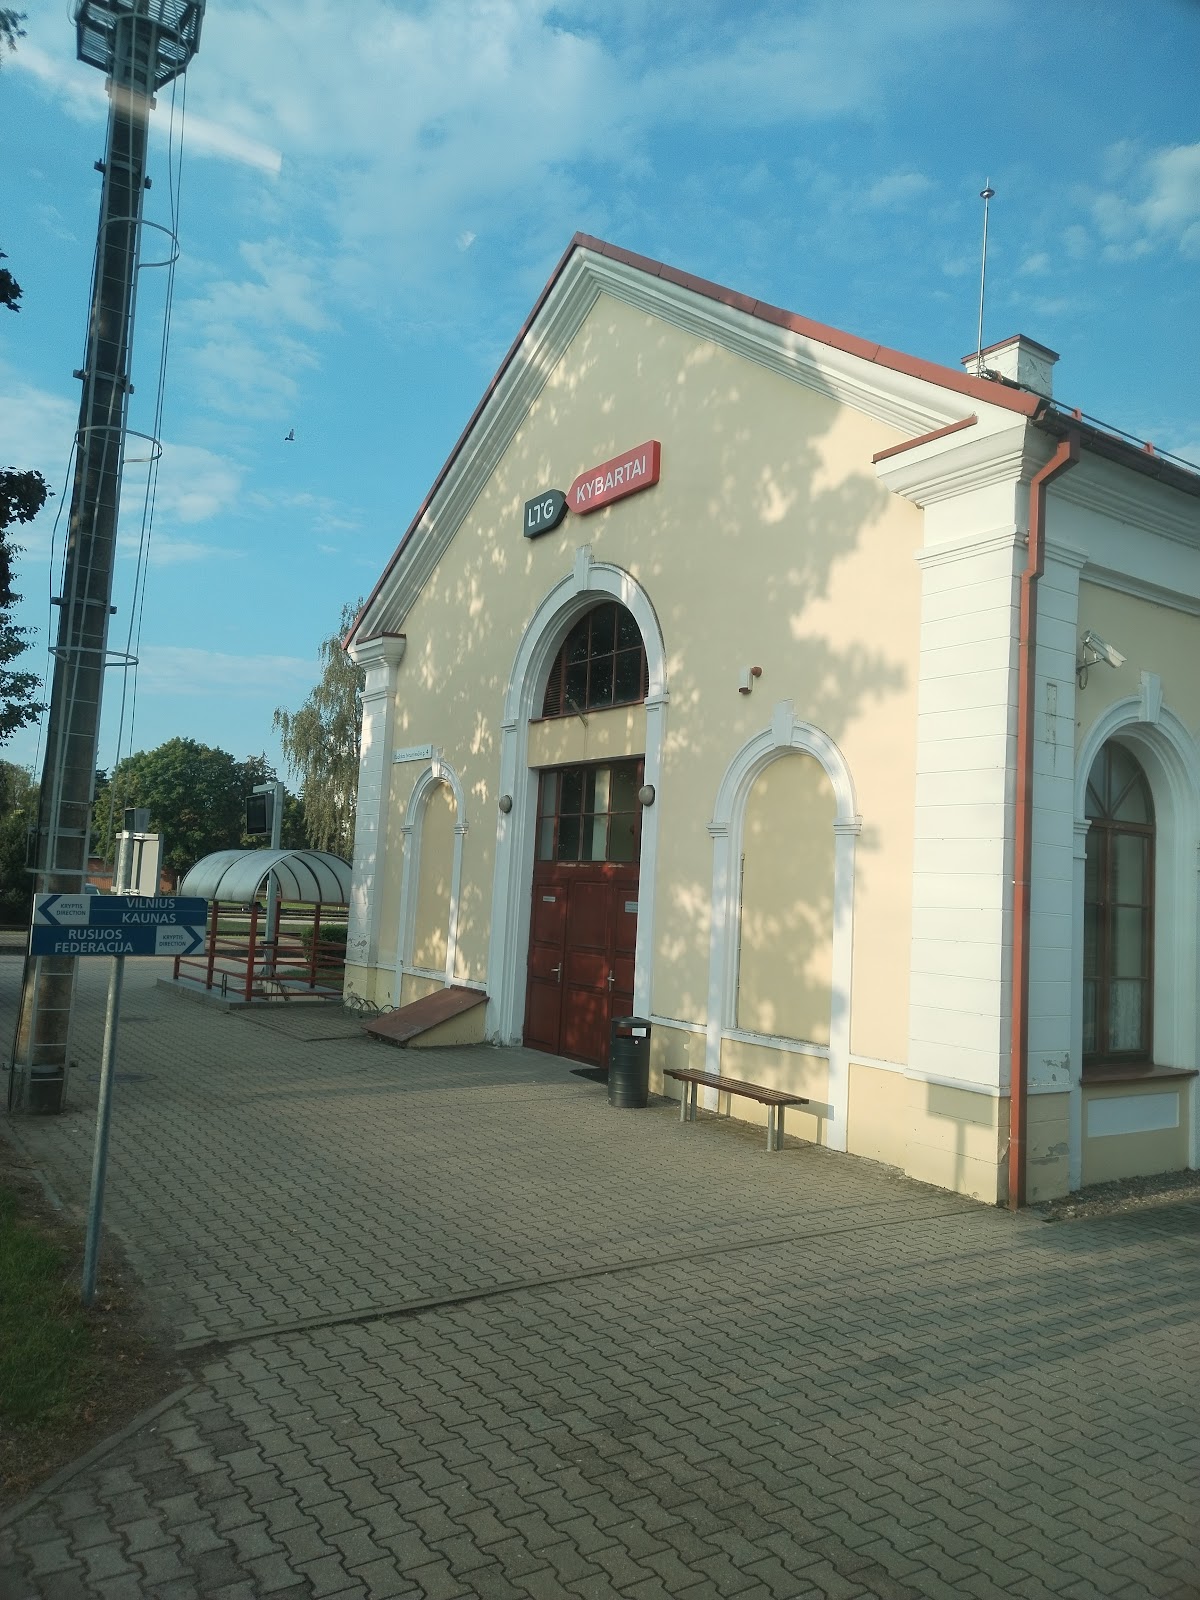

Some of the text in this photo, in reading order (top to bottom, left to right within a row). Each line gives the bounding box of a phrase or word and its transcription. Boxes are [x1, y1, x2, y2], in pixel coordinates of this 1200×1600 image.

[576, 455, 646, 504] KYBARTAI
[528, 498, 554, 527] LTG
[126, 897, 175, 908] VILNIUS
[122, 912, 177, 924] KAUNAS
[68, 929, 123, 940] RUSIJOS
[54, 942, 134, 953] FEDERACIJA
